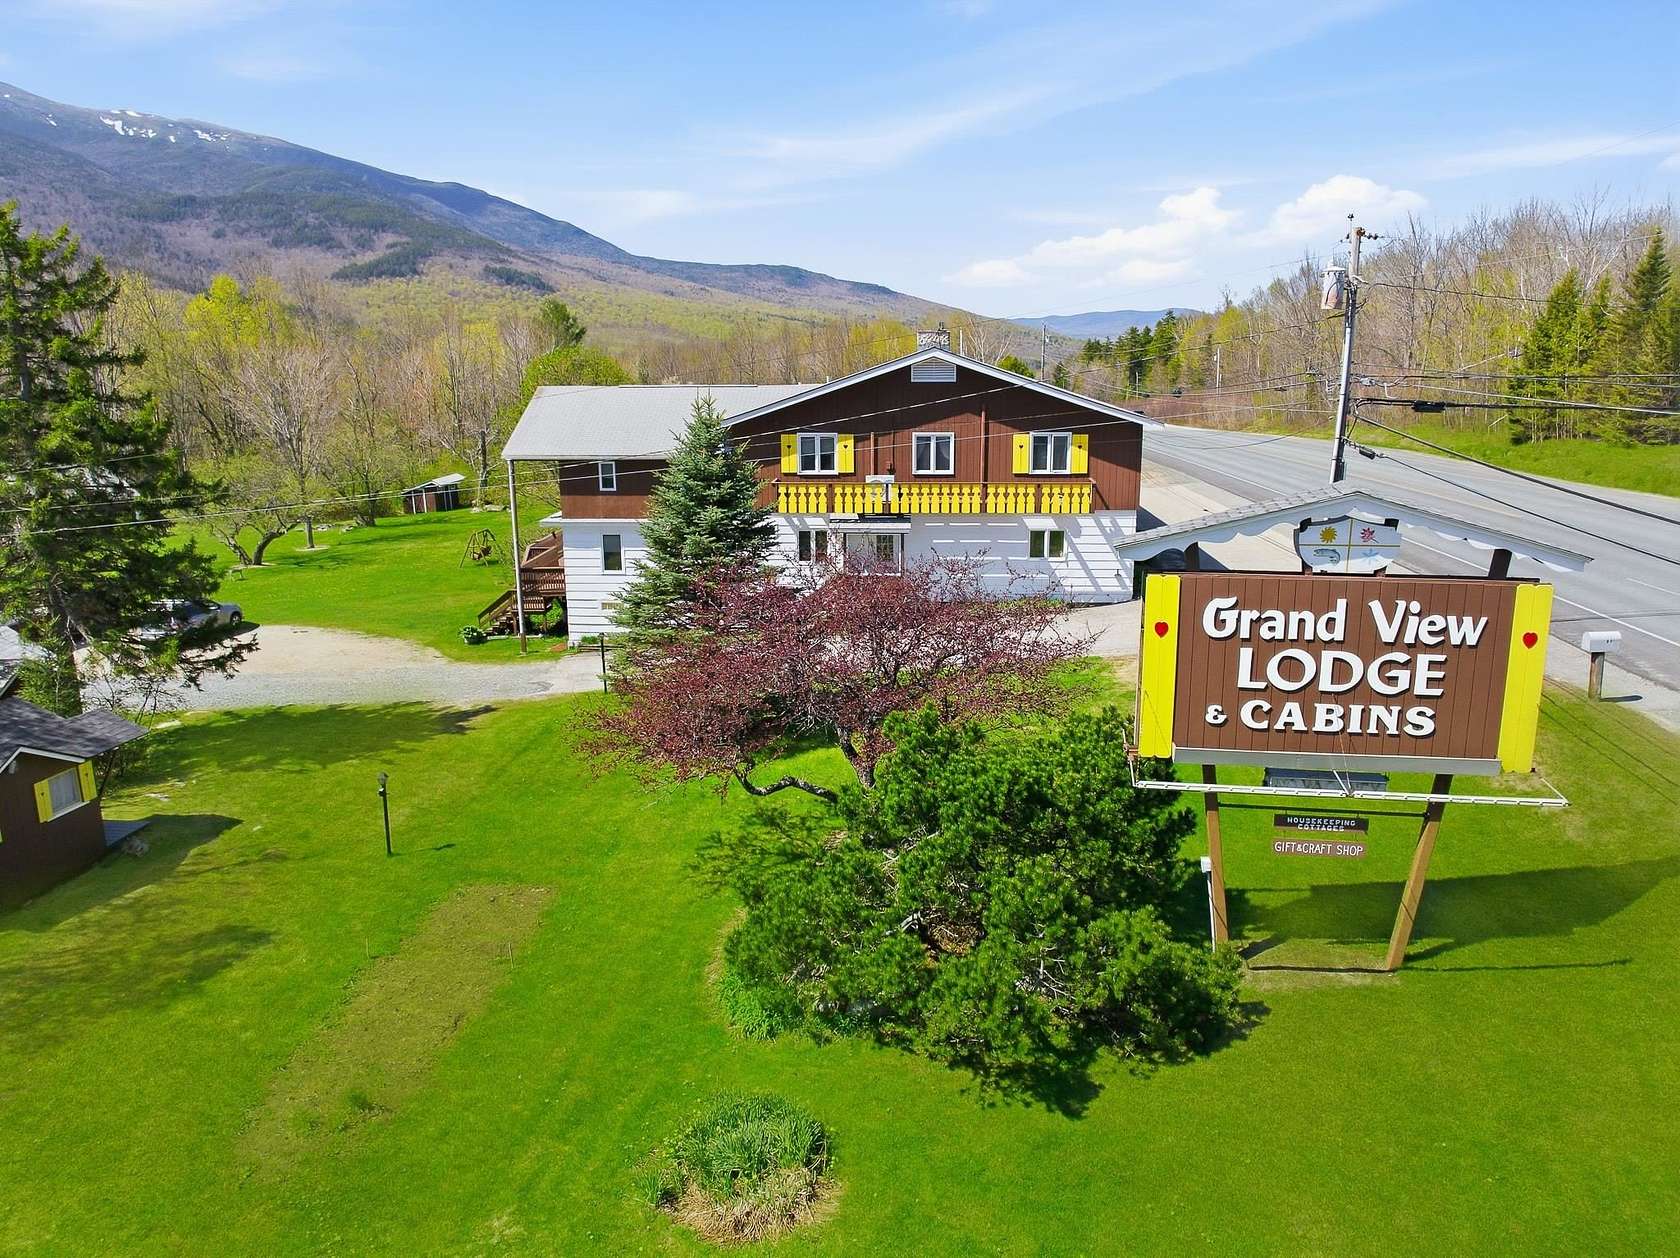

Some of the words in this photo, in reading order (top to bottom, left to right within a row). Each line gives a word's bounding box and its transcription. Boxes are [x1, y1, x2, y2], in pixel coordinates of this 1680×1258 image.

[1202, 596, 1347, 641] Grand
[1368, 600, 1488, 645] View
[1237, 647, 1448, 697] LODGE
[1205, 704, 1228, 724] &
[1239, 699, 1436, 736] CABINS
[1287, 817, 1356, 826] HOUSEKEEPING
[1297, 824, 1345, 832] COTTAGES
[1274, 841, 1332, 854] GIFT&CRAFT
[1336, 844, 1363, 856] SHOP
